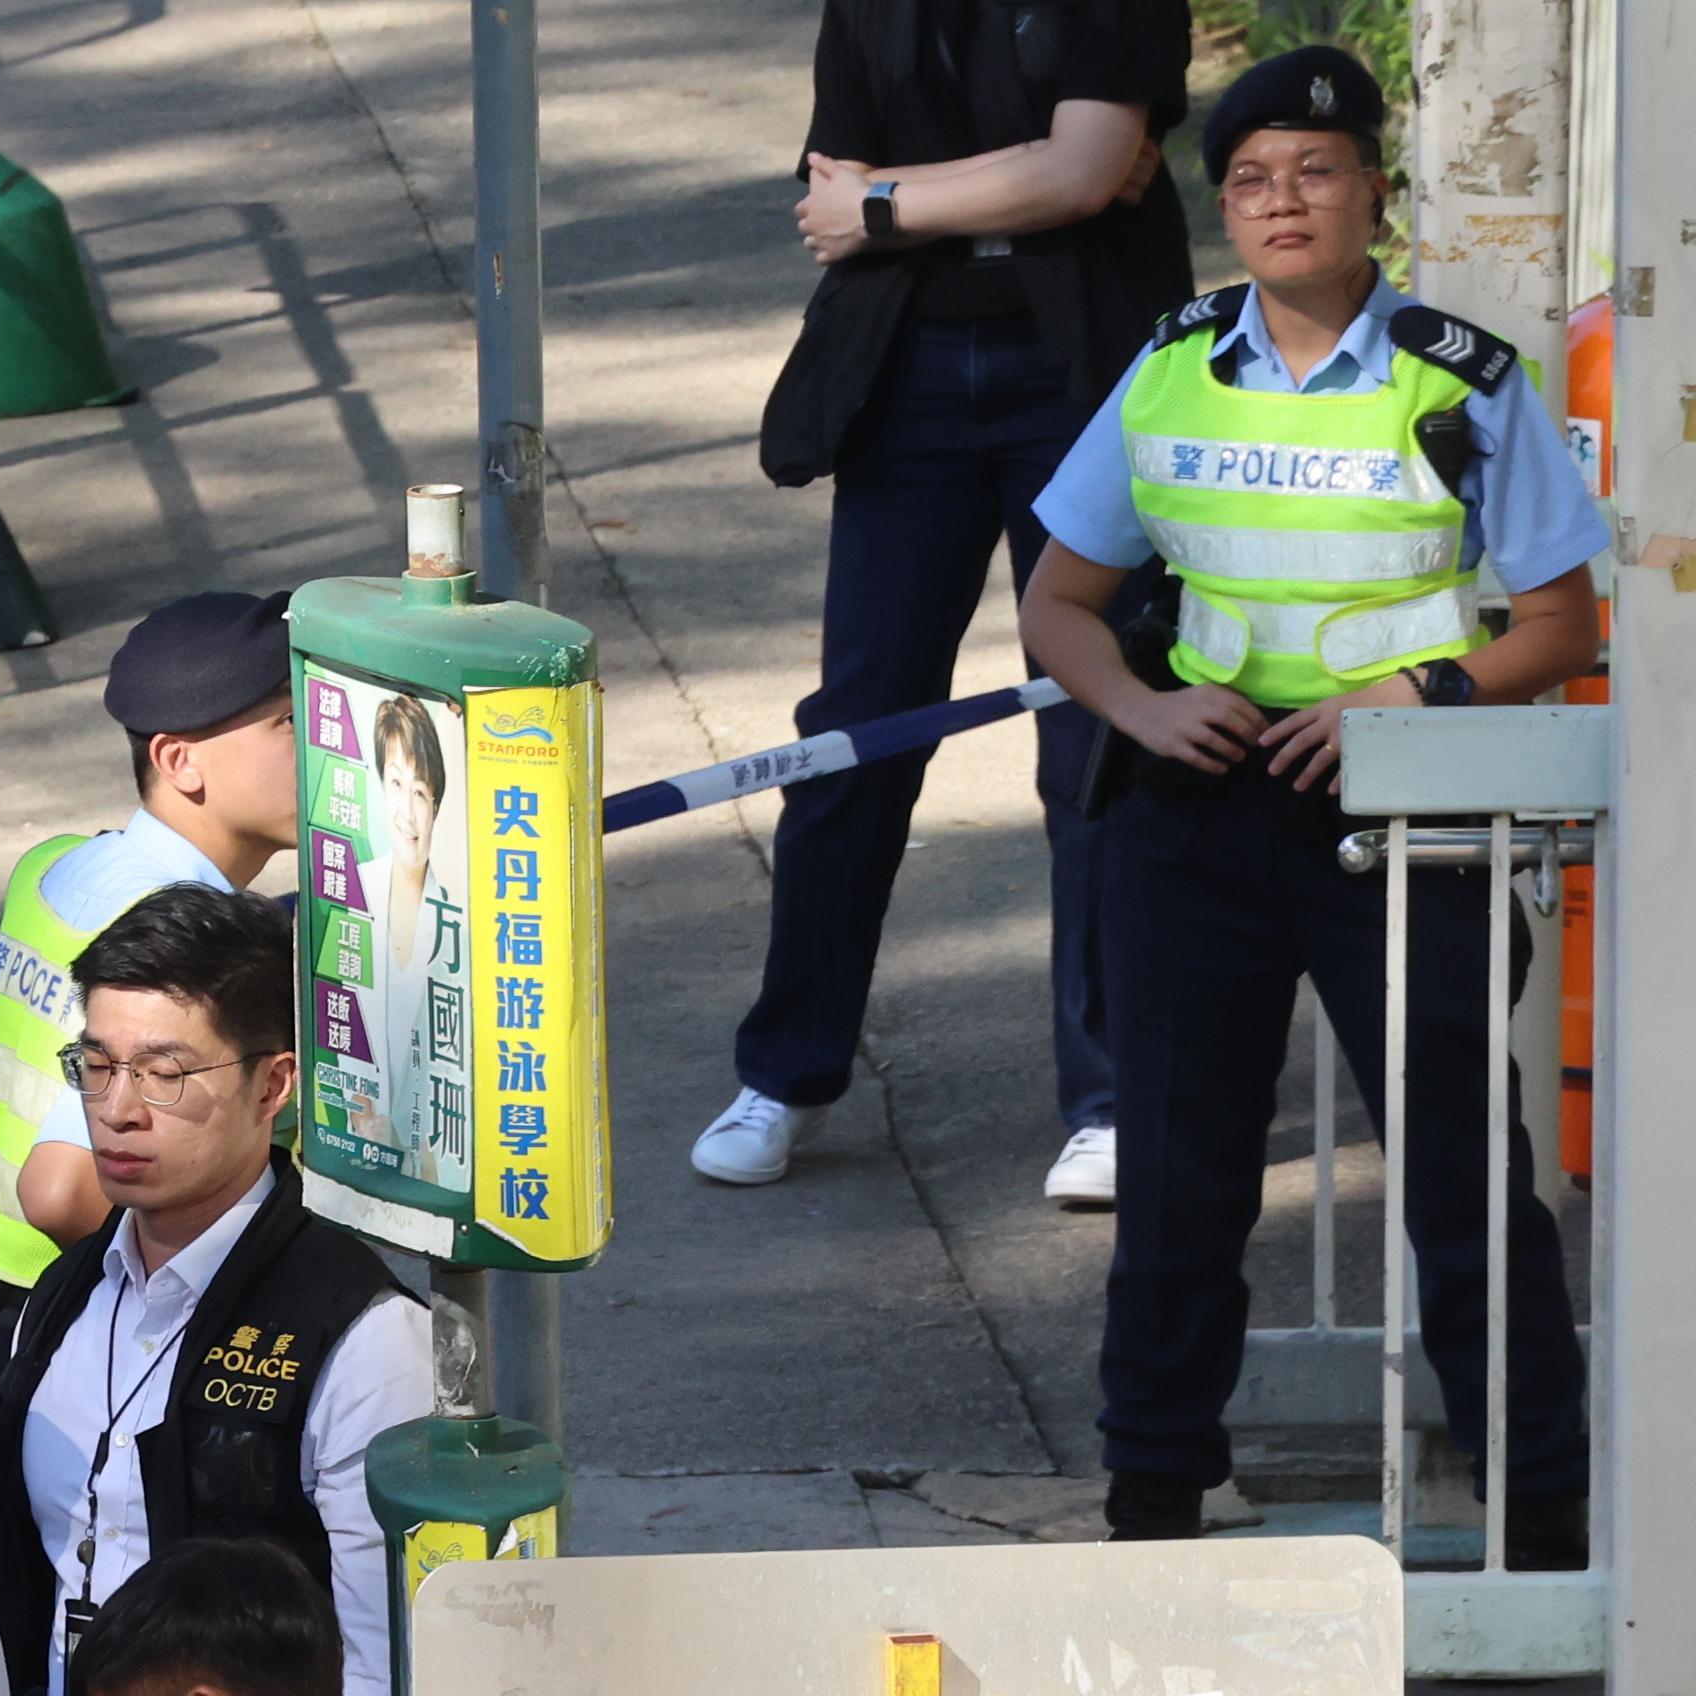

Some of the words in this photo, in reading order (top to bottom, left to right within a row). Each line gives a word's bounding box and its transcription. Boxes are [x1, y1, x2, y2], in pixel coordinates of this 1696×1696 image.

[1172, 444, 1203, 481] 警
[1217, 447, 1351, 490] POLICE
[1367, 457, 1401, 491] 察
[319, 687, 341, 718] 法律
[478, 741, 559, 758] STANFORD
[329, 796, 362, 831] 平安紙
[322, 839, 346, 871] 個案
[337, 919, 361, 951] 工程
[338, 949, 362, 981] 諮詢
[327, 990, 350, 1023] 送飯
[493, 785, 551, 1221] 史丹福游泳學校
[328, 1021, 352, 1054] 送暖
[424, 886, 466, 1166] 方國珊
[317, 1063, 357, 1093] CHRISTINE
[359, 1076, 379, 1100] FONG
[203, 1346, 300, 1381] POLICE
[204, 1378, 278, 1411] OCTB
